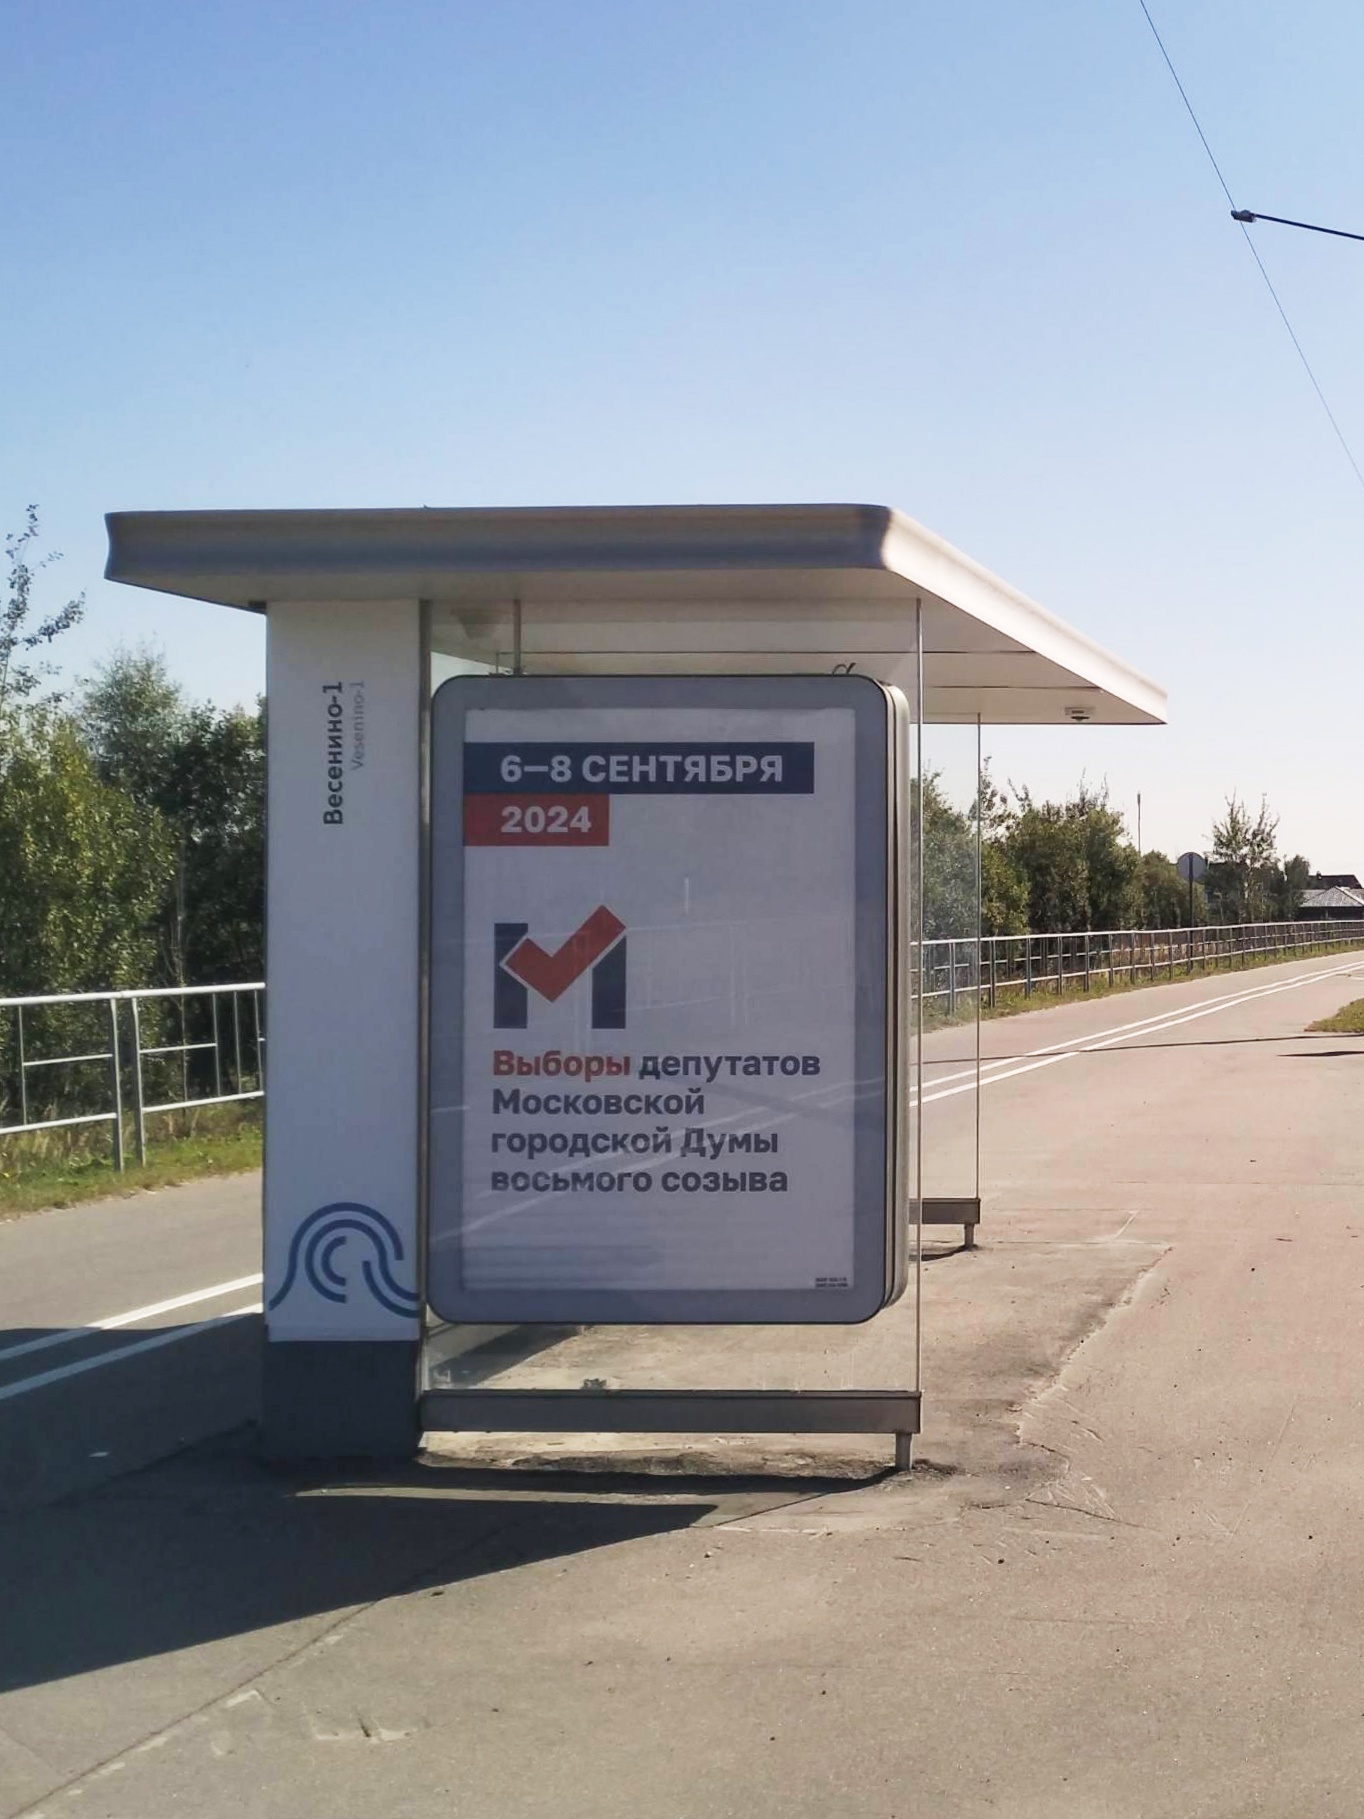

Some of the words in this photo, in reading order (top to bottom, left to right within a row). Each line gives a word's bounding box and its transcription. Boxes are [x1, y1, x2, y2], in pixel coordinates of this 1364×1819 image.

[322, 681, 344, 825] Весенино-1
[582, 755, 783, 783] СЕНТЯБРЯ
[500, 806, 592, 834] 2024
[492, 1050, 631, 1082] Выборы
[638, 1055, 821, 1082] депутатов
[492, 1088, 705, 1115] Московской
[491, 1127, 672, 1159] городской
[680, 1128, 778, 1159] Думы
[490, 1170, 652, 1193] восьмого
[661, 1170, 788, 1193] созыва
